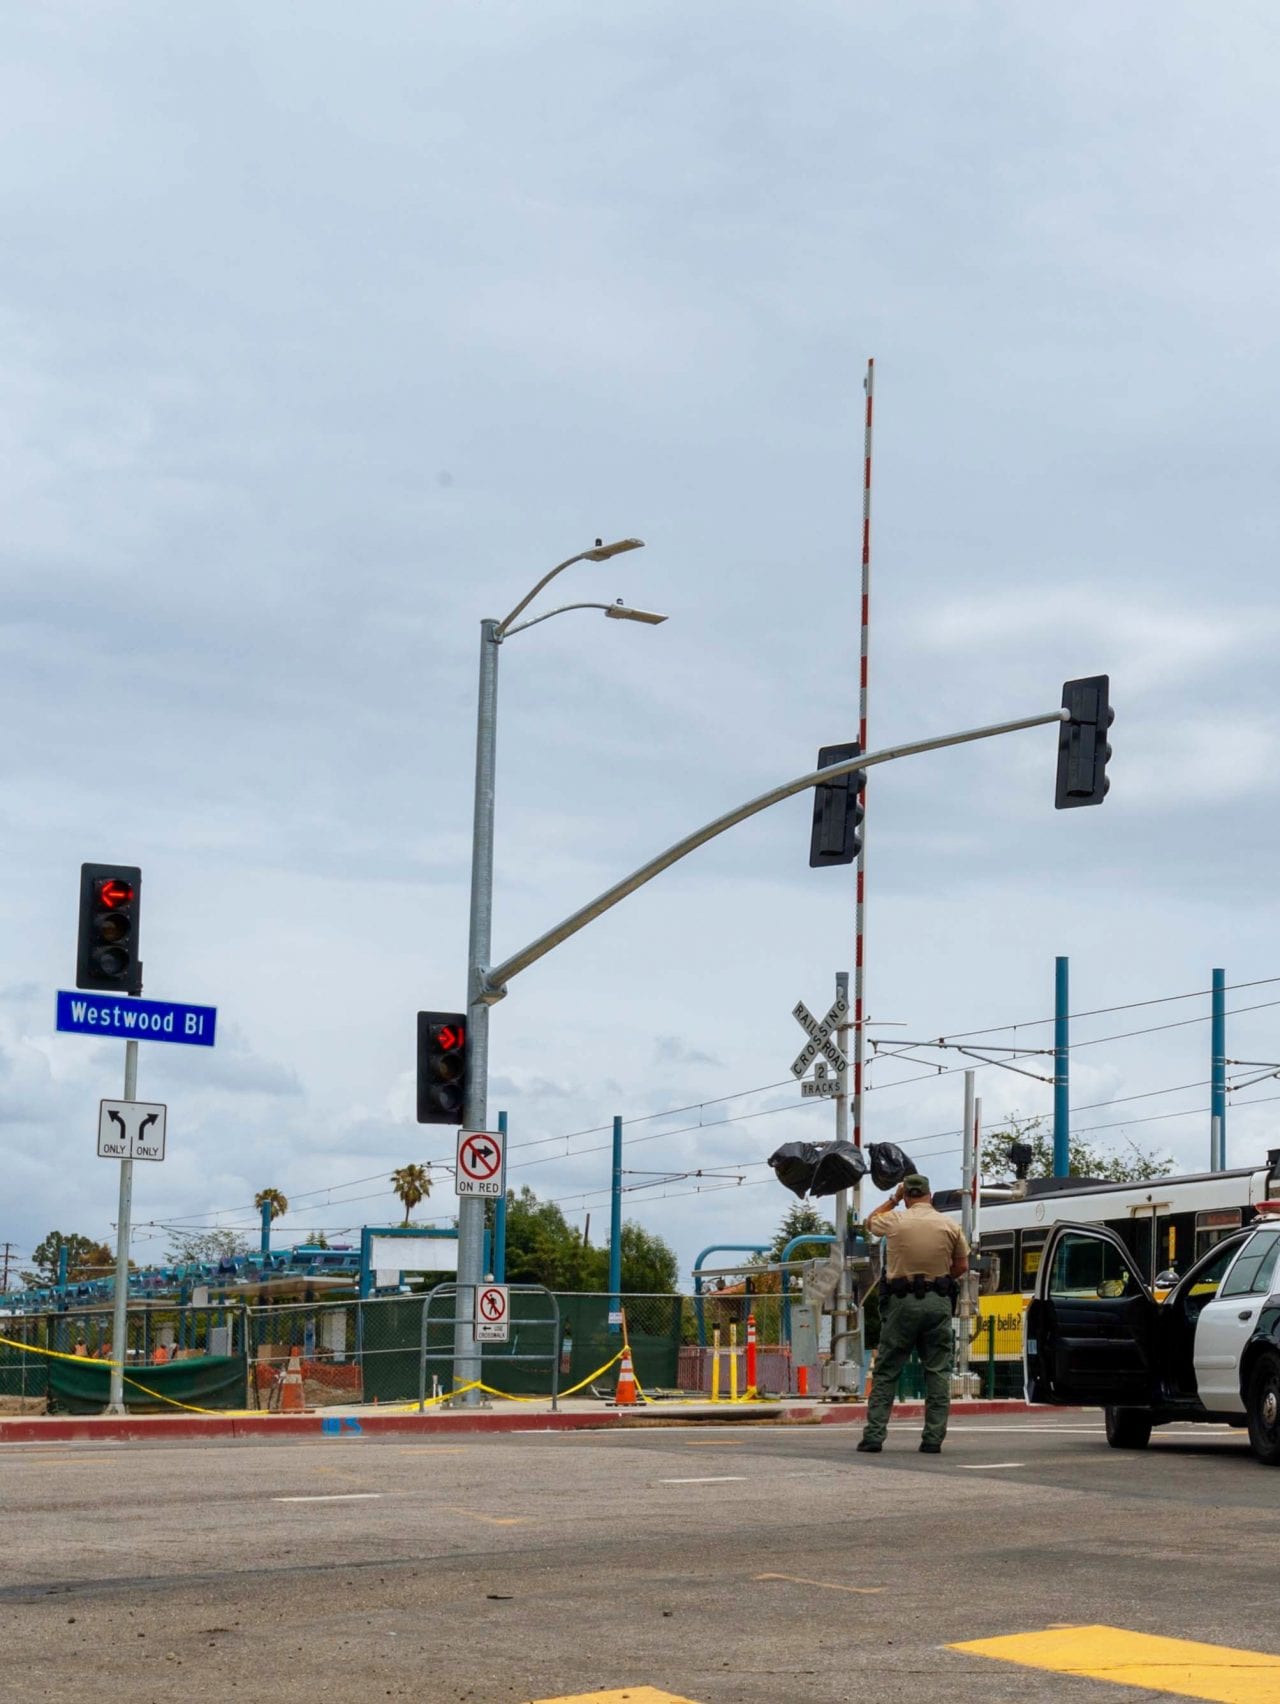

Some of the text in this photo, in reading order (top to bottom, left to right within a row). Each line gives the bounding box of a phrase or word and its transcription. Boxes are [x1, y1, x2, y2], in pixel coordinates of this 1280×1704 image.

[70, 1000, 204, 1036] Westwood Bl
[793, 1000, 846, 1075] CROSSING
[818, 1066, 825, 1079] 2
[803, 1081, 841, 1095] TRACKS
[103, 1144, 126, 1155] ONLY
[136, 1146, 159, 1157] ONLY
[459, 1181, 499, 1193] ON RED
[997, 1312, 1022, 1332] bells?
